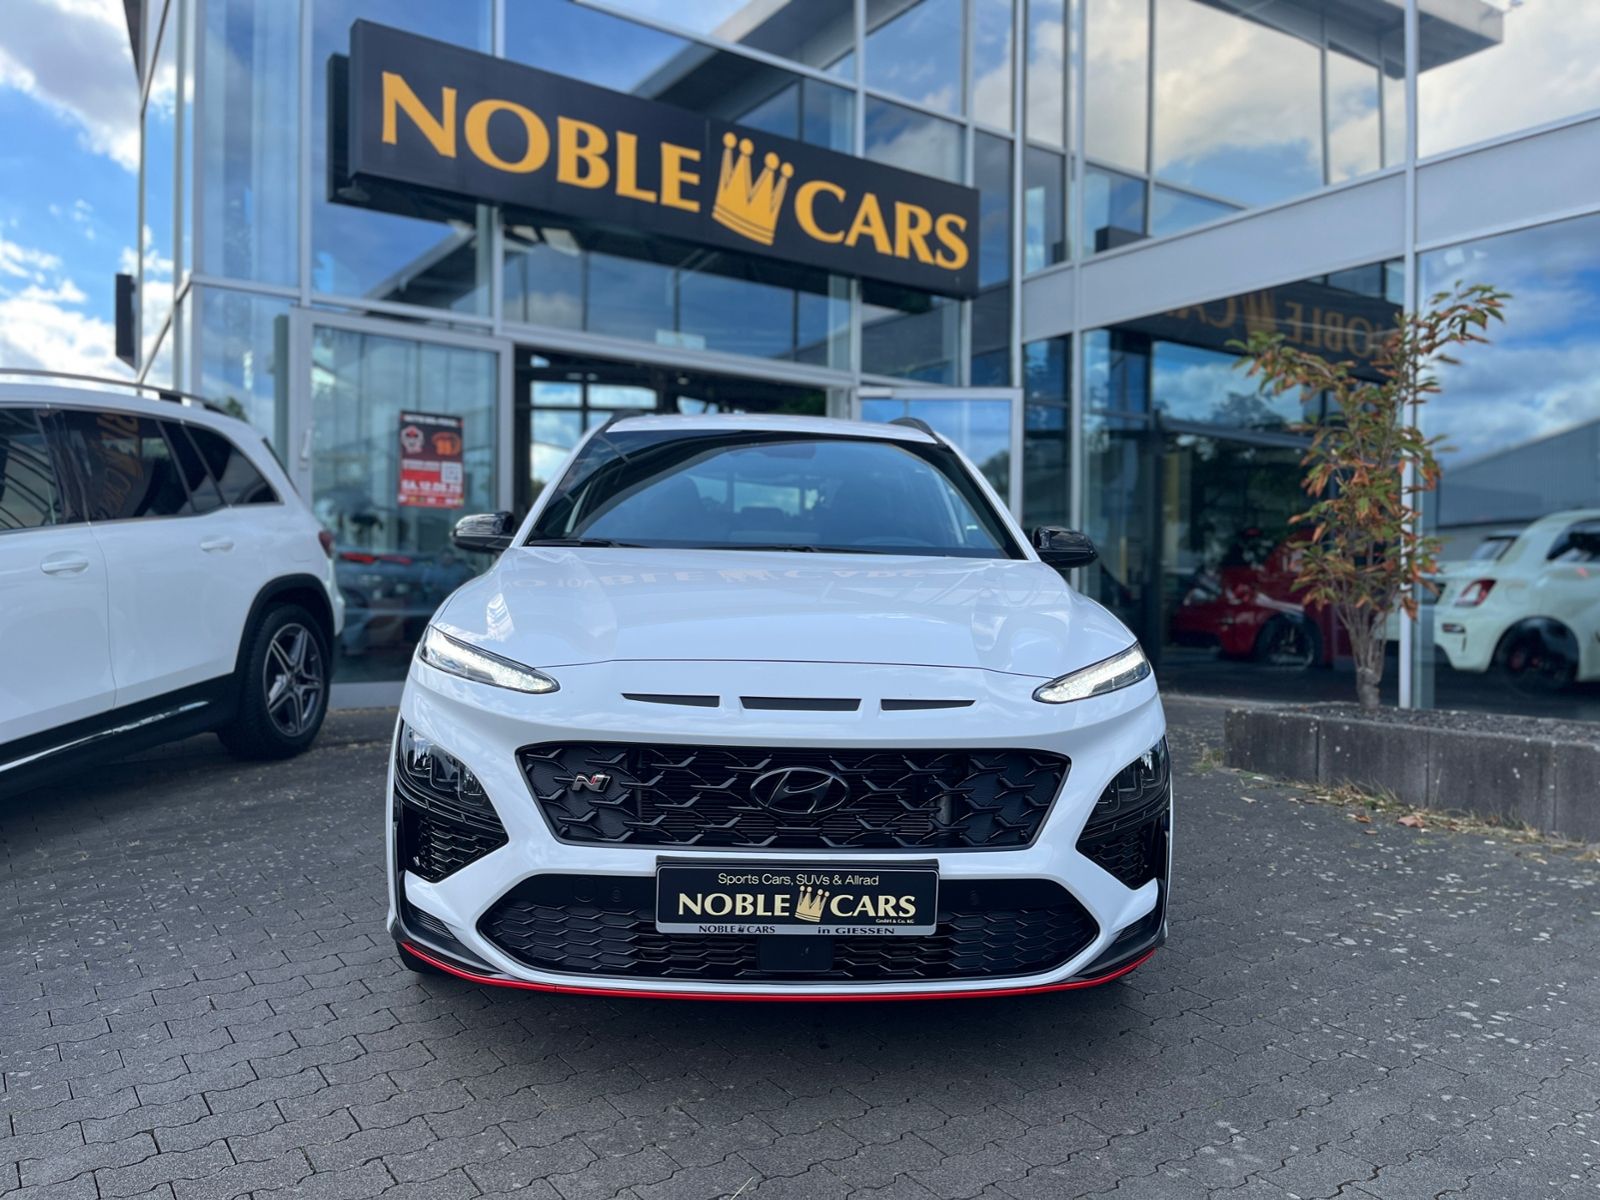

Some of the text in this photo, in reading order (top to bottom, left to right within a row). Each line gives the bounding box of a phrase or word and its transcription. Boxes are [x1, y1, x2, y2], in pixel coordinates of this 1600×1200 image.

[382, 70, 970, 271] NOBLE CARS
[718, 872, 880, 887] Sports Cars, SUVs & Allrad
[678, 892, 917, 918] NOBLE CARS
[698, 924, 895, 935] NOBLE CARS in GIESSEN
